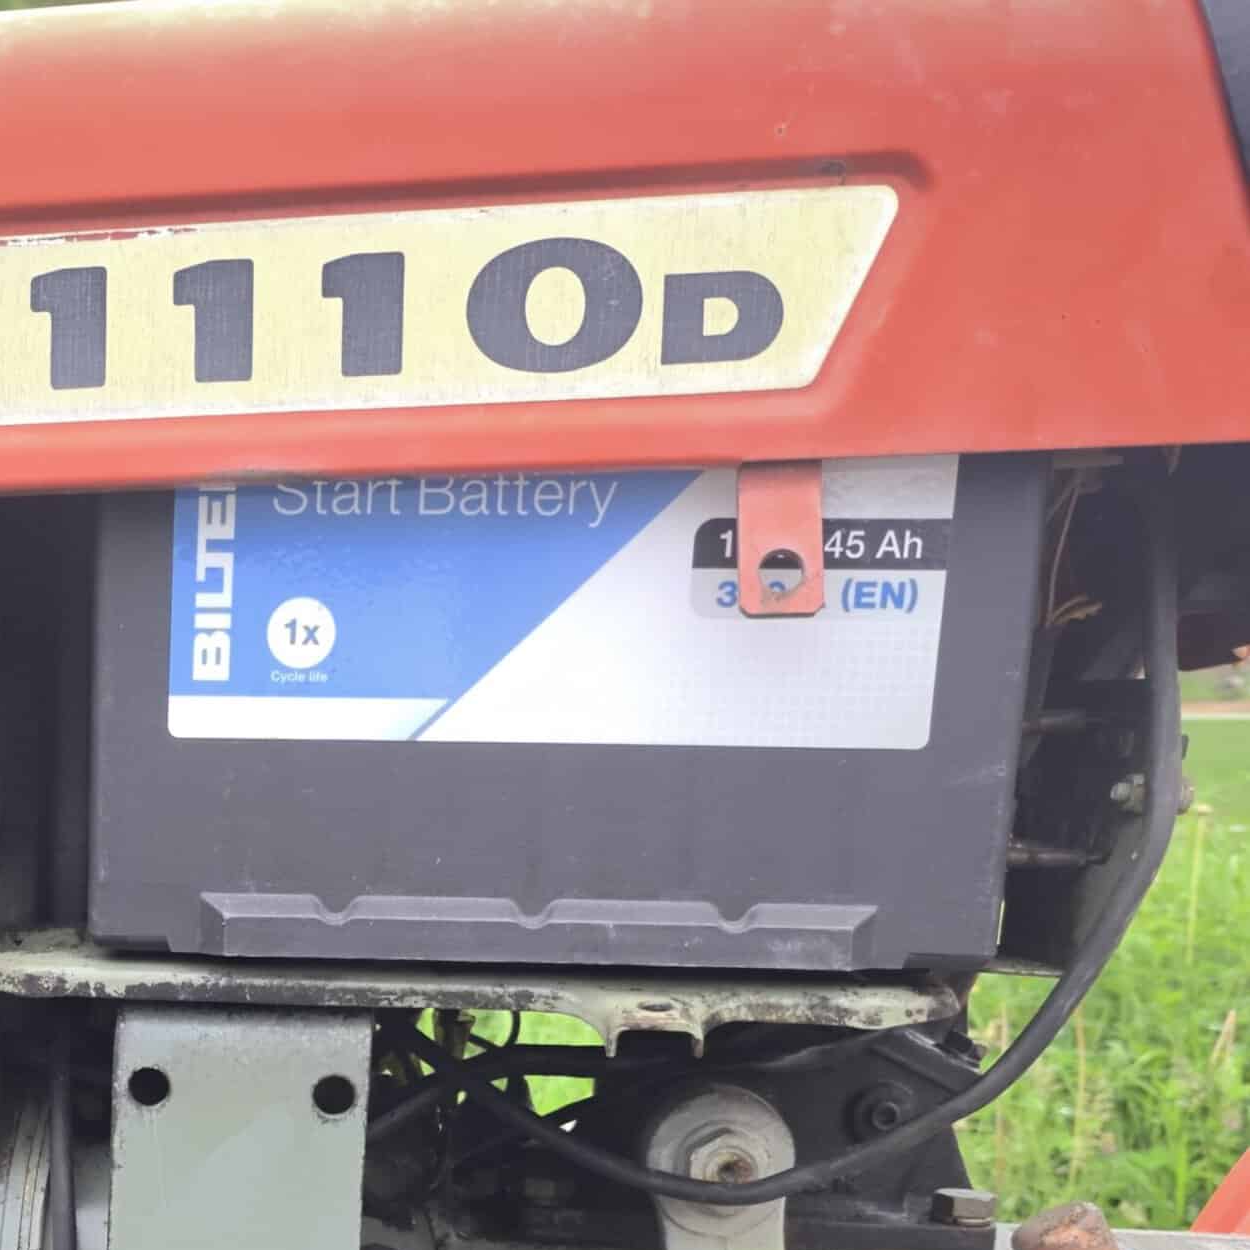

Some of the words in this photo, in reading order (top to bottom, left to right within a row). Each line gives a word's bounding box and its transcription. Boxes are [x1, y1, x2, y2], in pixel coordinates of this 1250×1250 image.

[30, 237, 785, 390] 1110D
[272, 477, 403, 516] Start
[418, 472, 618, 528] Battery
[824, 531, 865, 559] 45
[875, 530, 923, 559] Ah
[841, 578, 919, 613] (EN)
[283, 617, 321, 646] 1x
